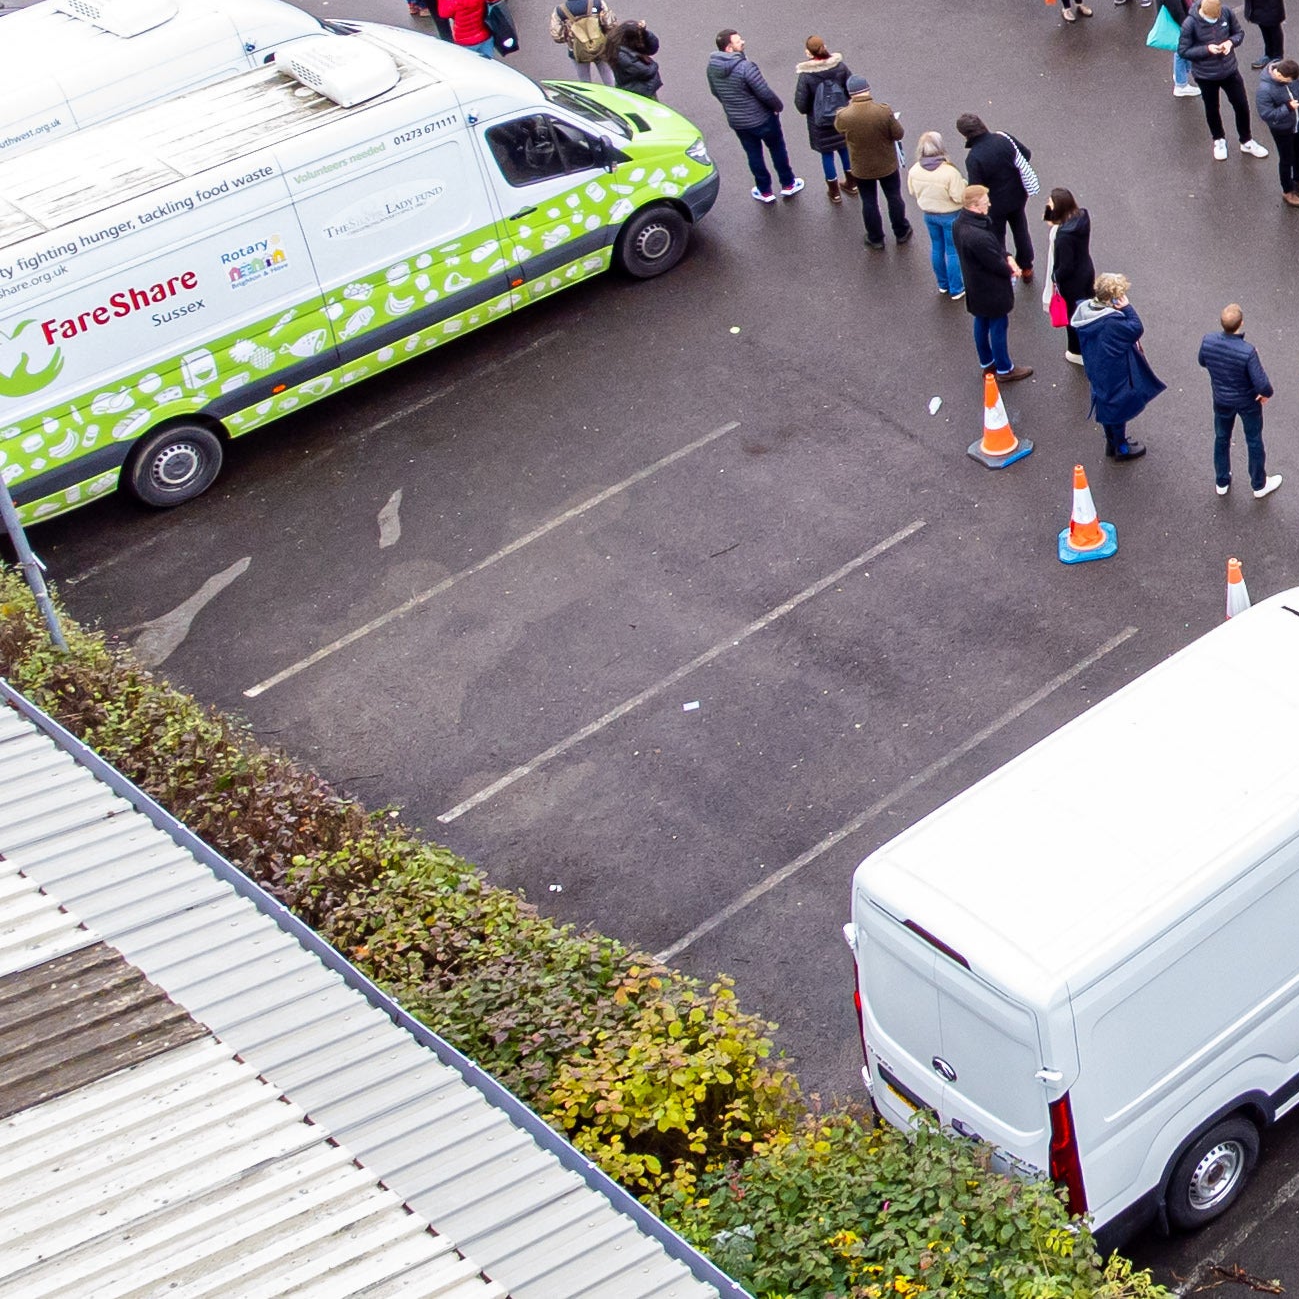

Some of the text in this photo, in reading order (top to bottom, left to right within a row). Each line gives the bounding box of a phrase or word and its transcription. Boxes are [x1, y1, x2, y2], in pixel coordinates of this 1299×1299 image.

[293, 115, 458, 185] Volunteers needed 01273 671111
[385, 196, 414, 215] LADY
[415, 186, 444, 202] FUND
[16, 242, 78, 271] fighting
[78, 220, 137, 248] hunger,
[137, 196, 195, 224] tackling
[196, 180, 230, 202] food
[231, 165, 274, 188] waste
[221, 239, 268, 264] Rotary
[231, 274, 262, 290] Brighton
[270, 263, 288, 273] Hove
[41, 270, 199, 346] FareShare
[151, 299, 206, 327] Sussex
